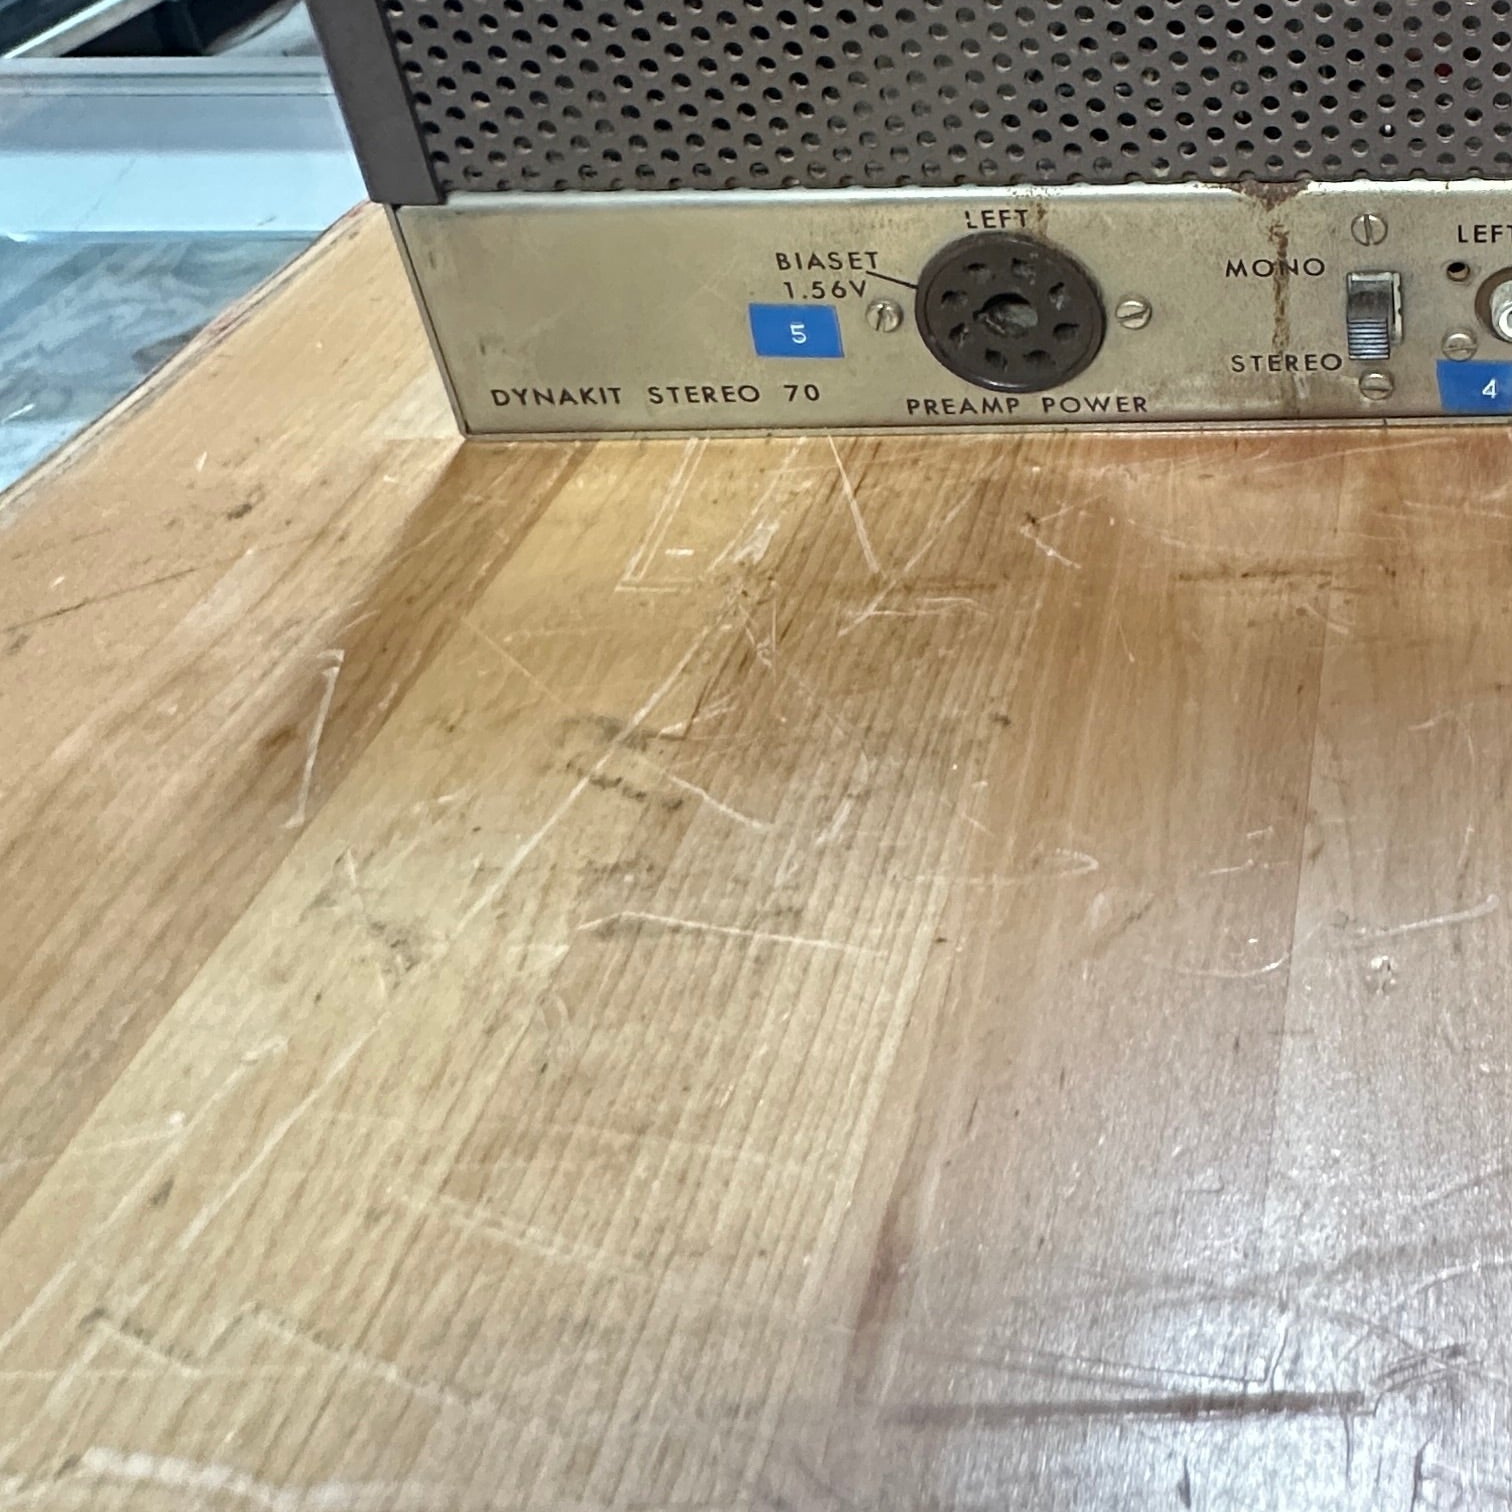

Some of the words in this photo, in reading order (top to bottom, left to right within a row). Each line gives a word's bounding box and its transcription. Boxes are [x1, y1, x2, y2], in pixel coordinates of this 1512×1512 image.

[964, 208, 1029, 230] LEFT
[775, 251, 878, 271] BIASET
[1225, 256, 1326, 278] MONO
[783, 279, 866, 300] 1.56V
[789, 323, 807, 344] 5
[1231, 352, 1343, 373] STEREO
[490, 386, 621, 407] DYNAKIT
[647, 384, 761, 405] STEREO
[783, 383, 820, 402] 70
[1481, 378, 1497, 399] 4
[906, 396, 1022, 416] PREAMP
[1042, 396, 1149, 414] POWER
